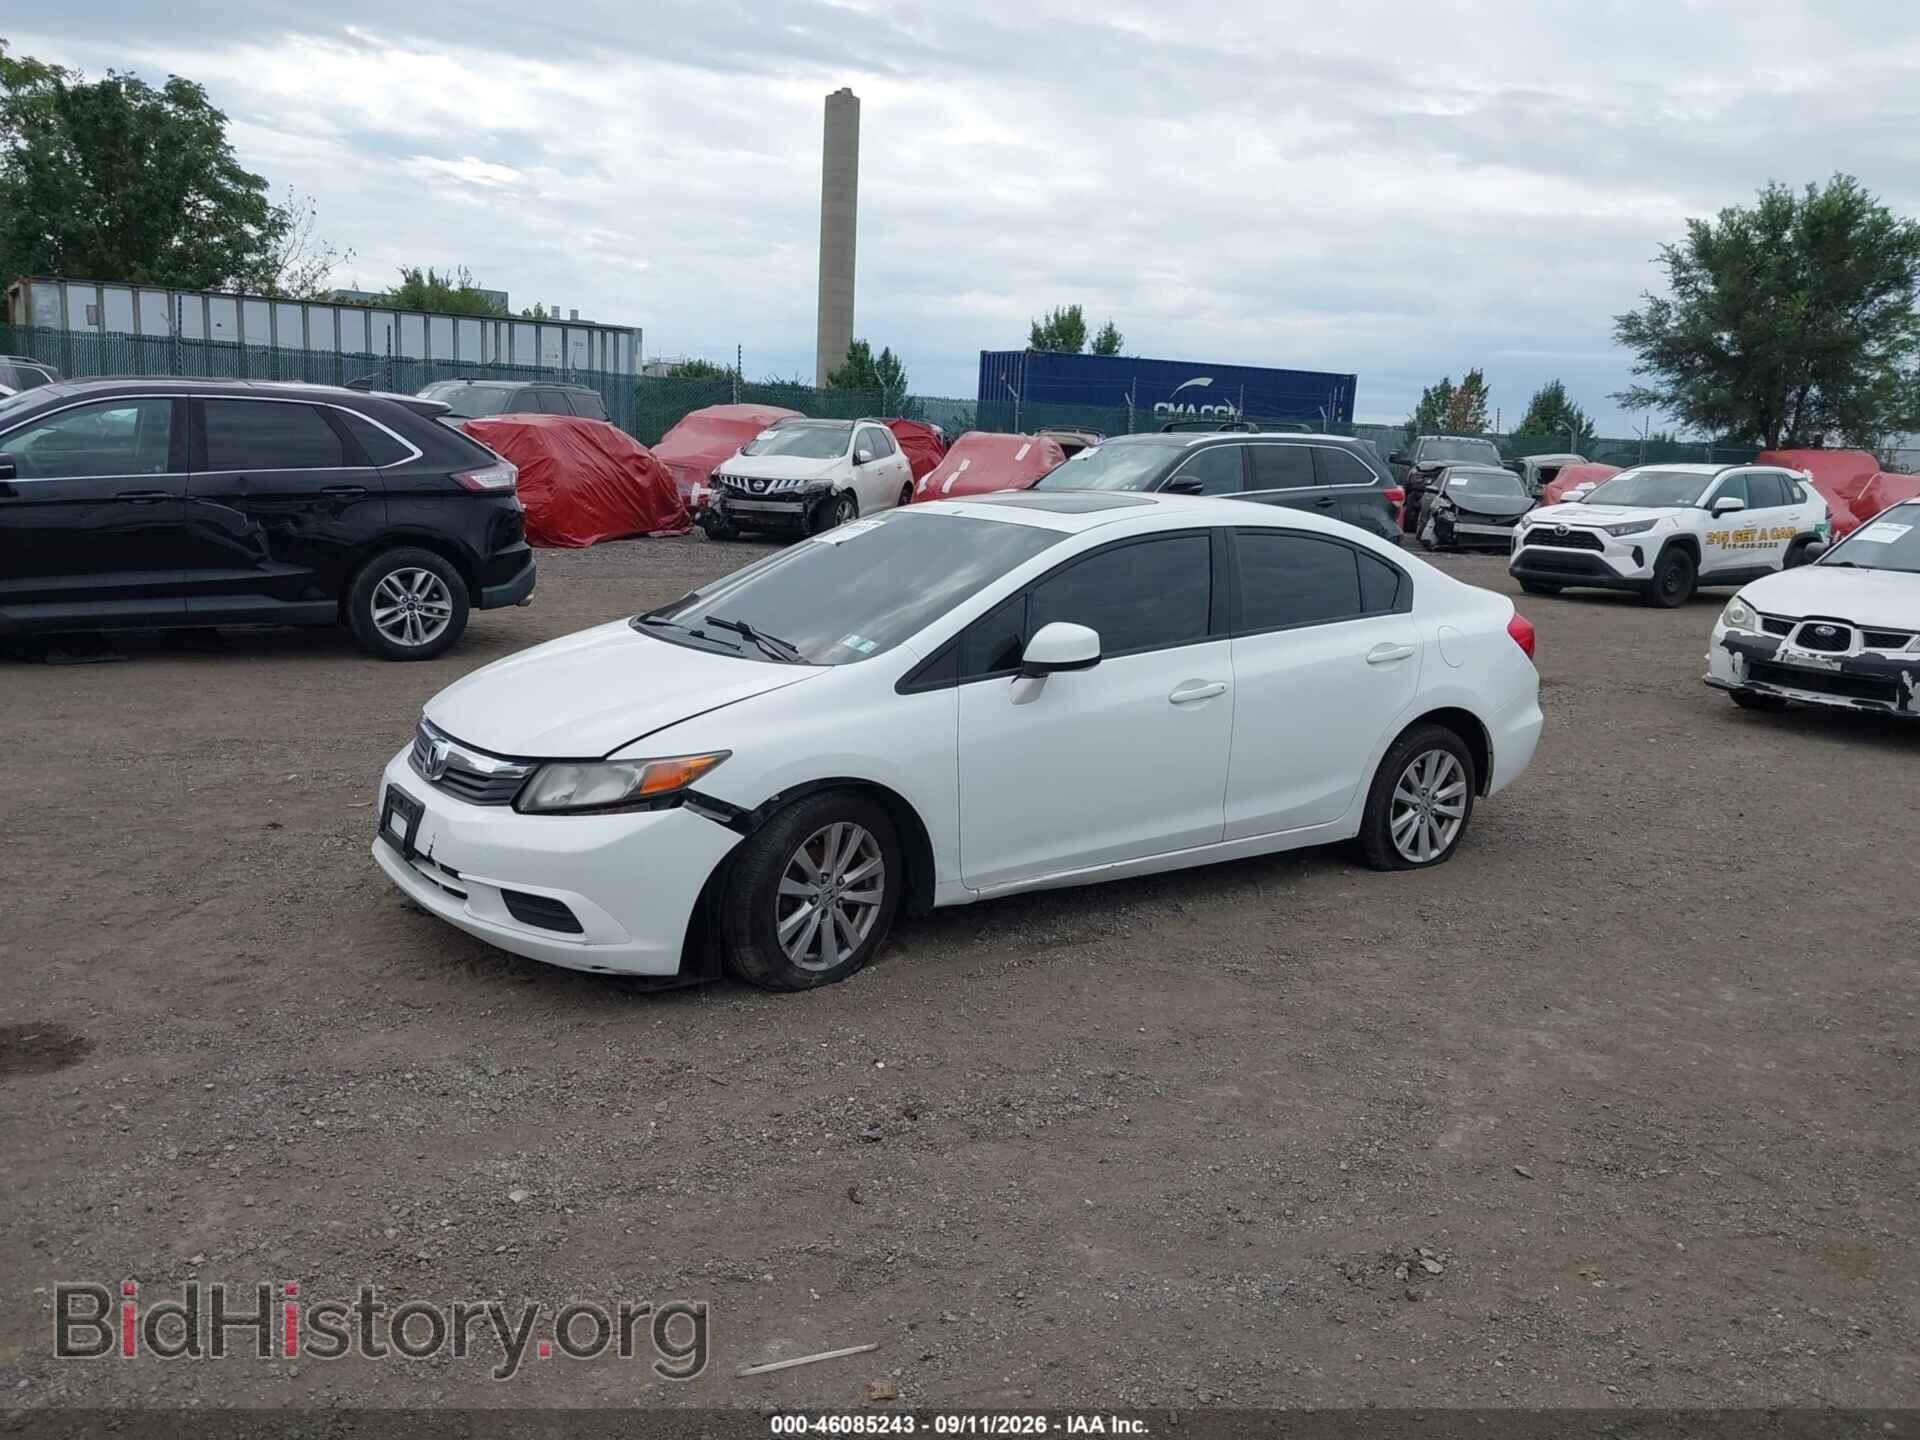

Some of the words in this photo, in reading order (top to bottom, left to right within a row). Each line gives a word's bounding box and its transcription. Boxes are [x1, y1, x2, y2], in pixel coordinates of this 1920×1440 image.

[1154, 402, 1196, 420] CMA
[1706, 530, 1730, 545] 215
[1732, 528, 1758, 542] GET
[1759, 527, 1769, 540] A
